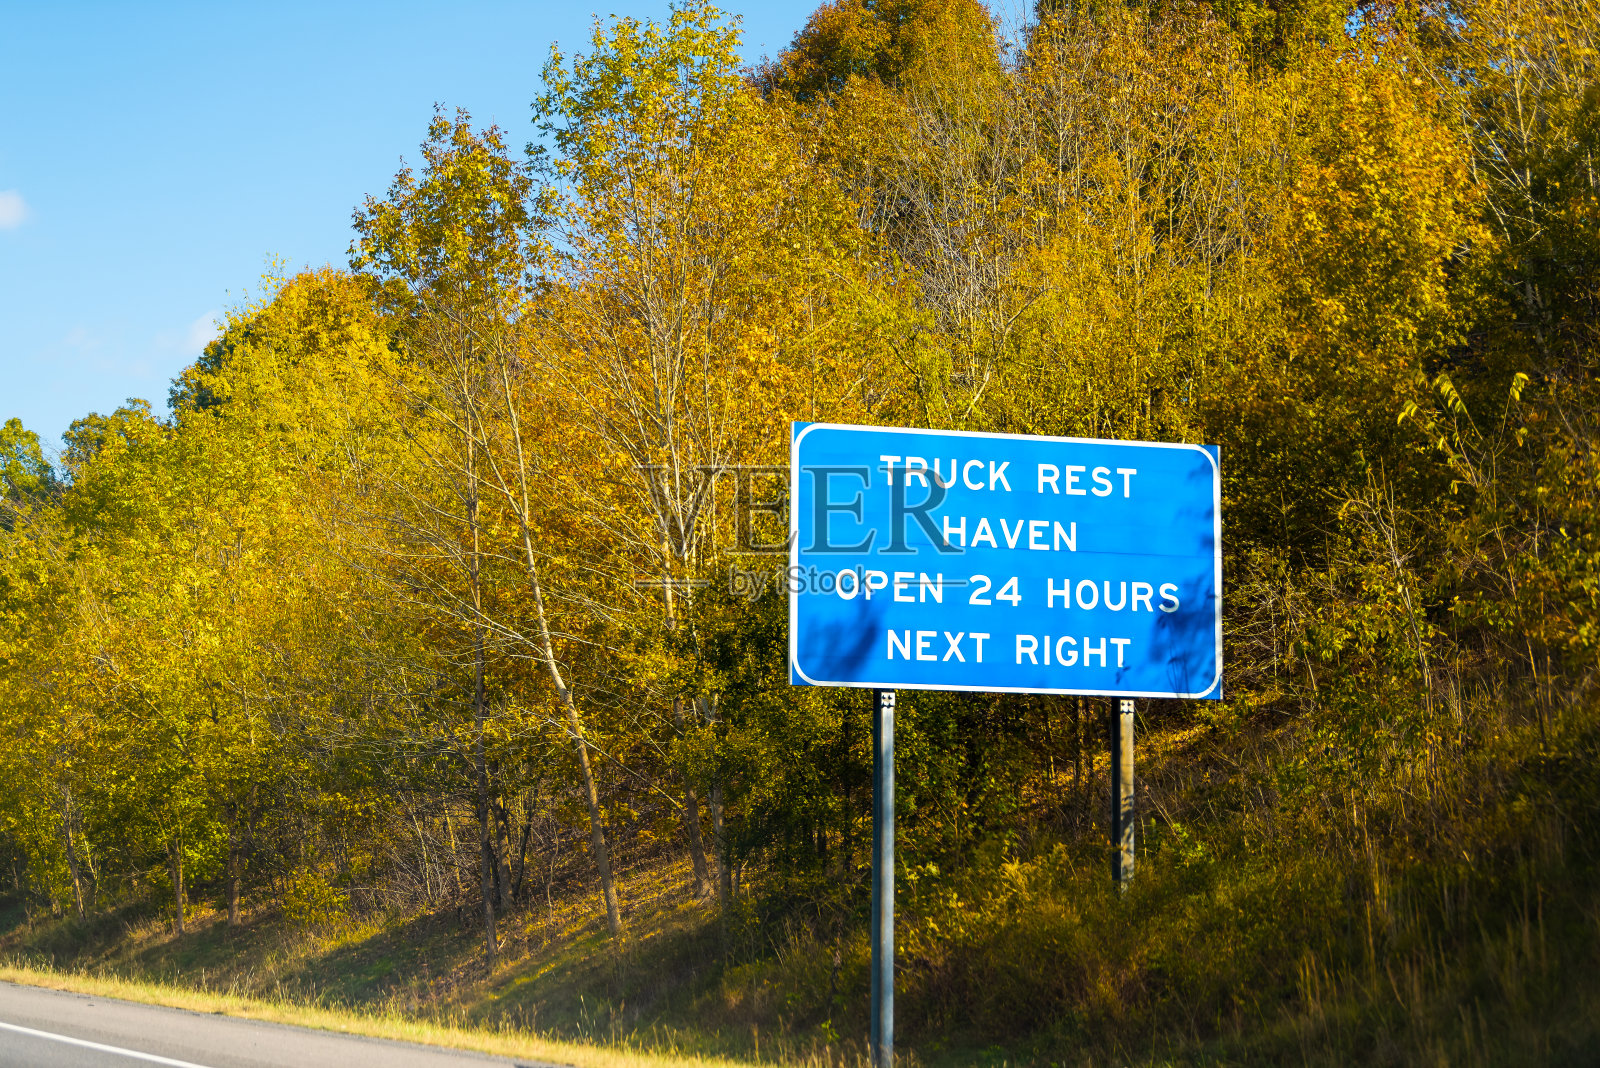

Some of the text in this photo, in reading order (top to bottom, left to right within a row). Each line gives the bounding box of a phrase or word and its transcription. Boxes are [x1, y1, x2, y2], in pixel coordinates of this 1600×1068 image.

[880, 455, 1137, 498] TRUCK REST
[943, 515, 1077, 552] HAVEN
[835, 568, 1180, 613] OPEN 24 HOURS
[887, 629, 1131, 668] NEXT RIGHT
